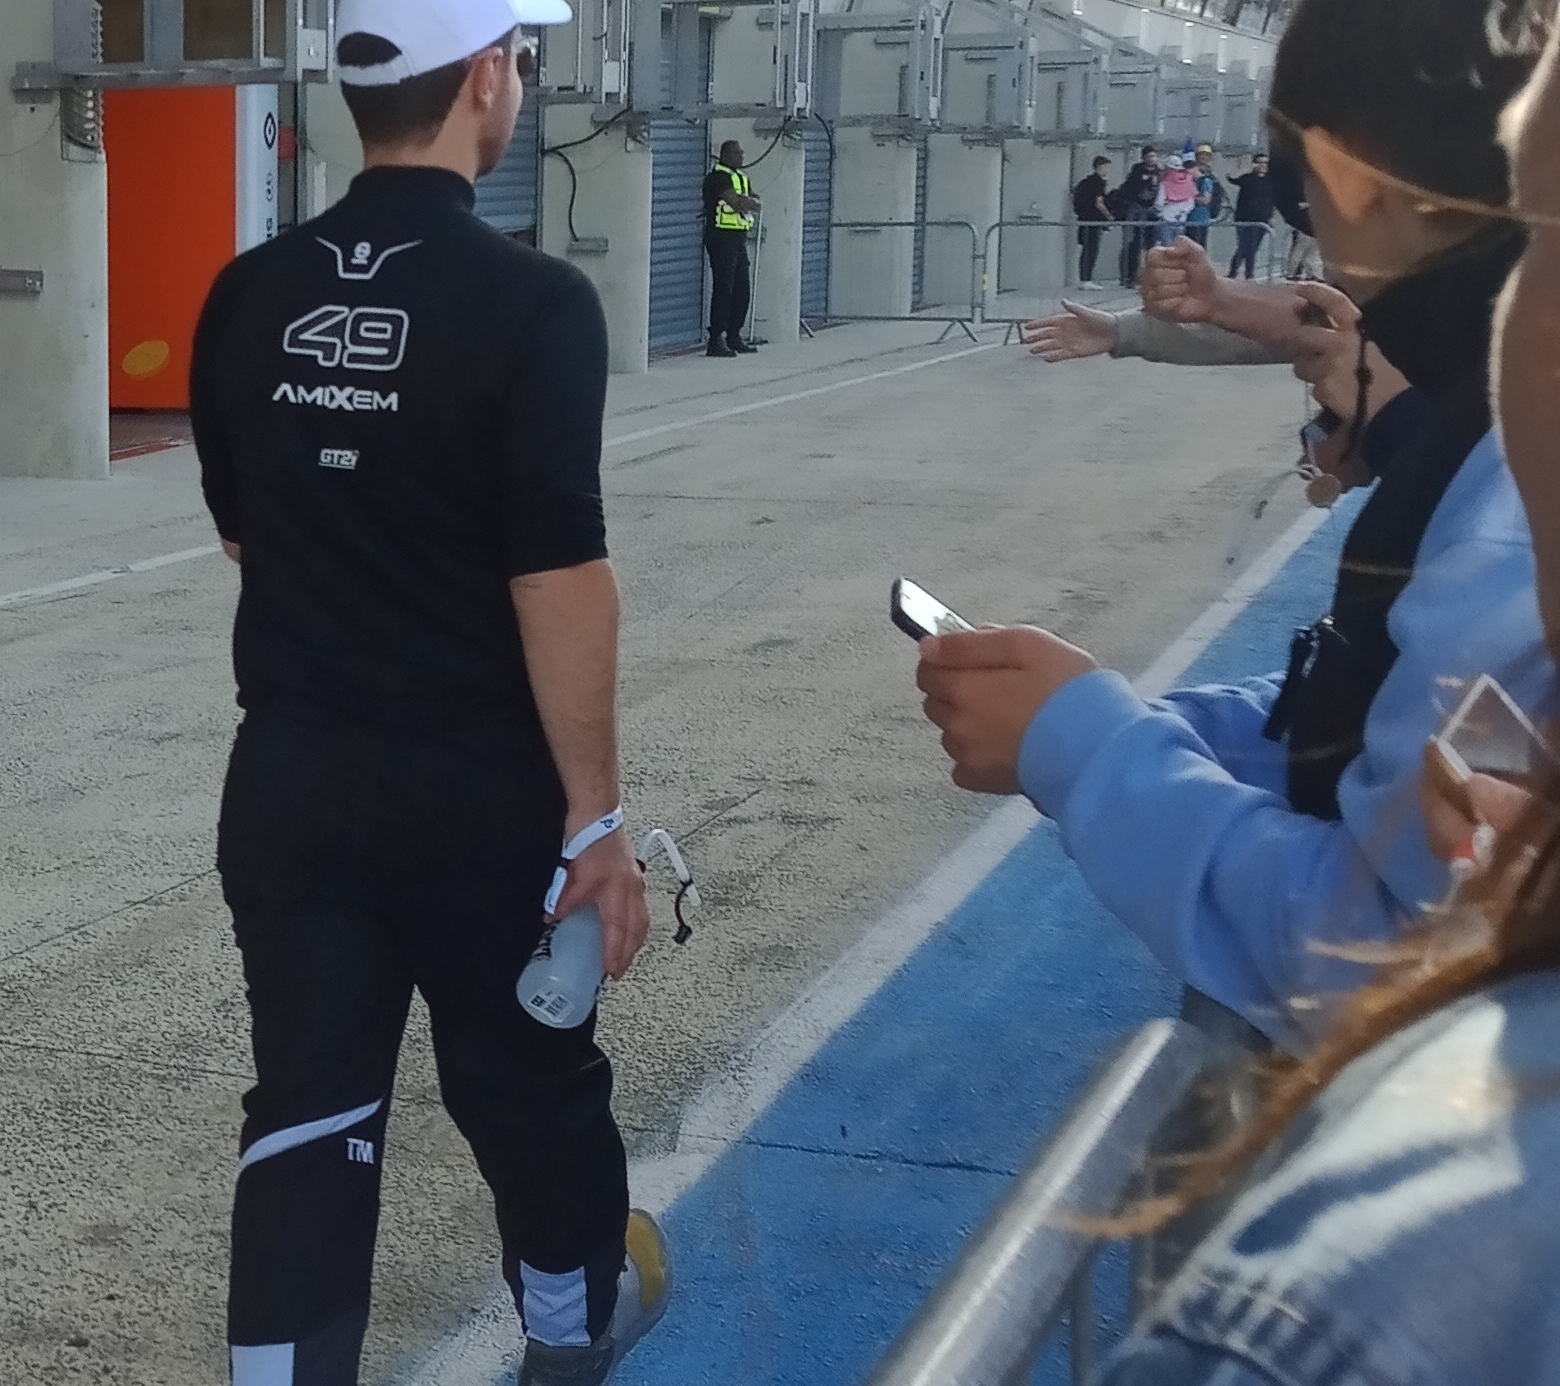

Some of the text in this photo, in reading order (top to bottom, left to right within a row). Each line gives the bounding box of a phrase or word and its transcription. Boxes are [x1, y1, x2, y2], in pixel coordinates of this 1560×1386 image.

[284, 305, 409, 371] 49
[272, 383, 399, 412] AMIXEM
[347, 1137, 374, 1164] TM
